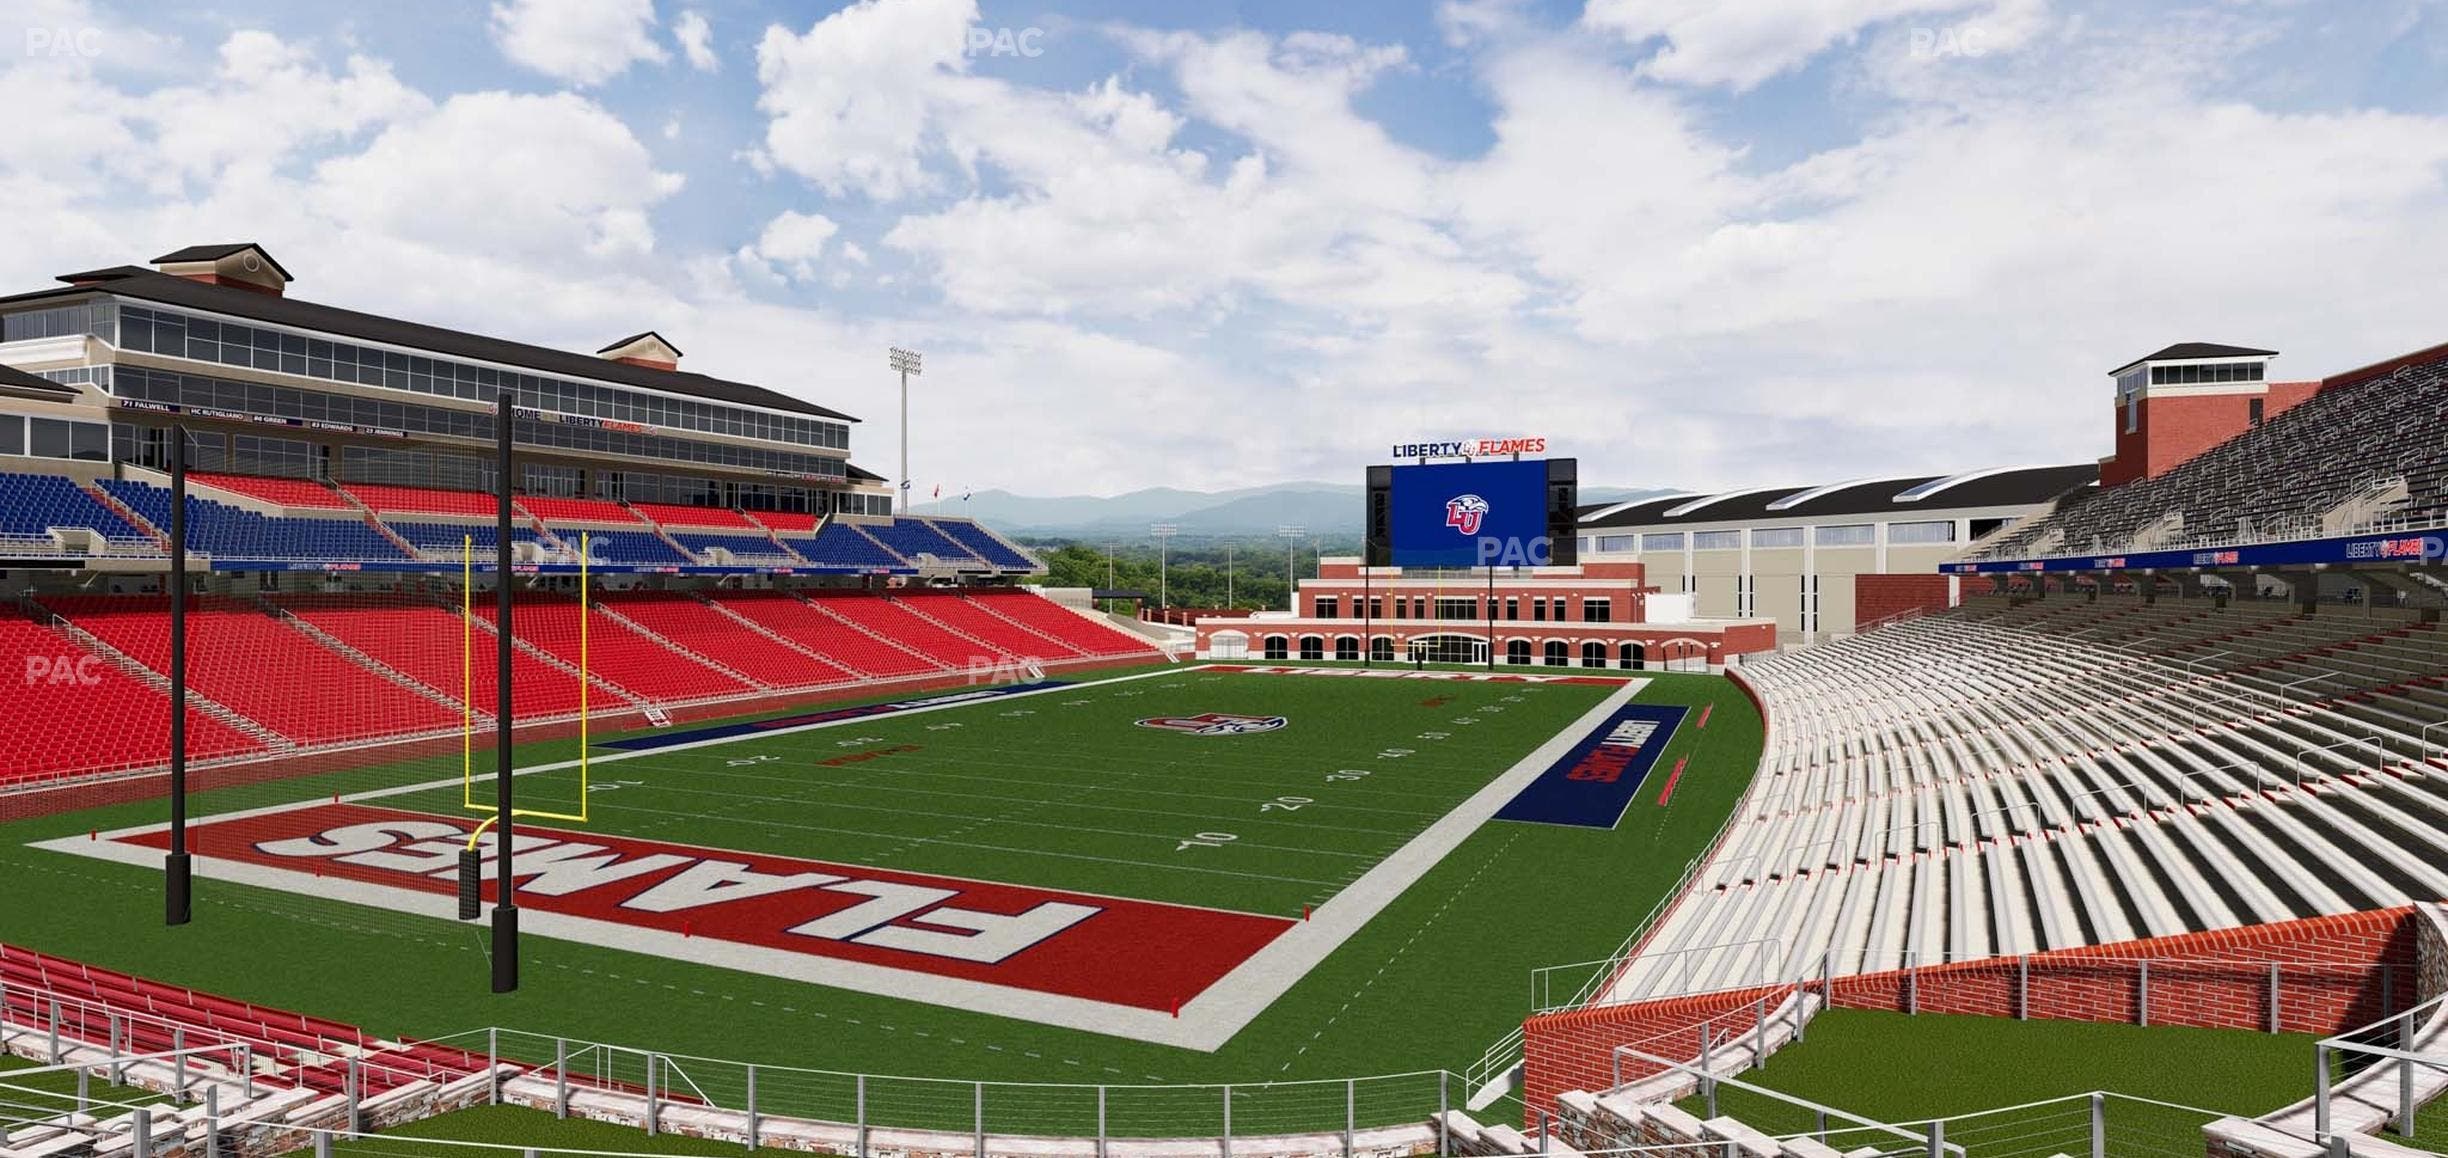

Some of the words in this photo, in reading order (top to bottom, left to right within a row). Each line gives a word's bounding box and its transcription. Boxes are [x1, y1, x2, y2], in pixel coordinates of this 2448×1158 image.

[135, 402, 171, 412] FALWELL
[559, 414, 604, 429] LIBERTY
[1393, 442, 1462, 458] LIBERTY
[1478, 438, 1546, 455] FLAMES
[1261, 796, 1315, 812] 20
[1176, 832, 1238, 851] 10
[251, 819, 1104, 964] FLAMES
